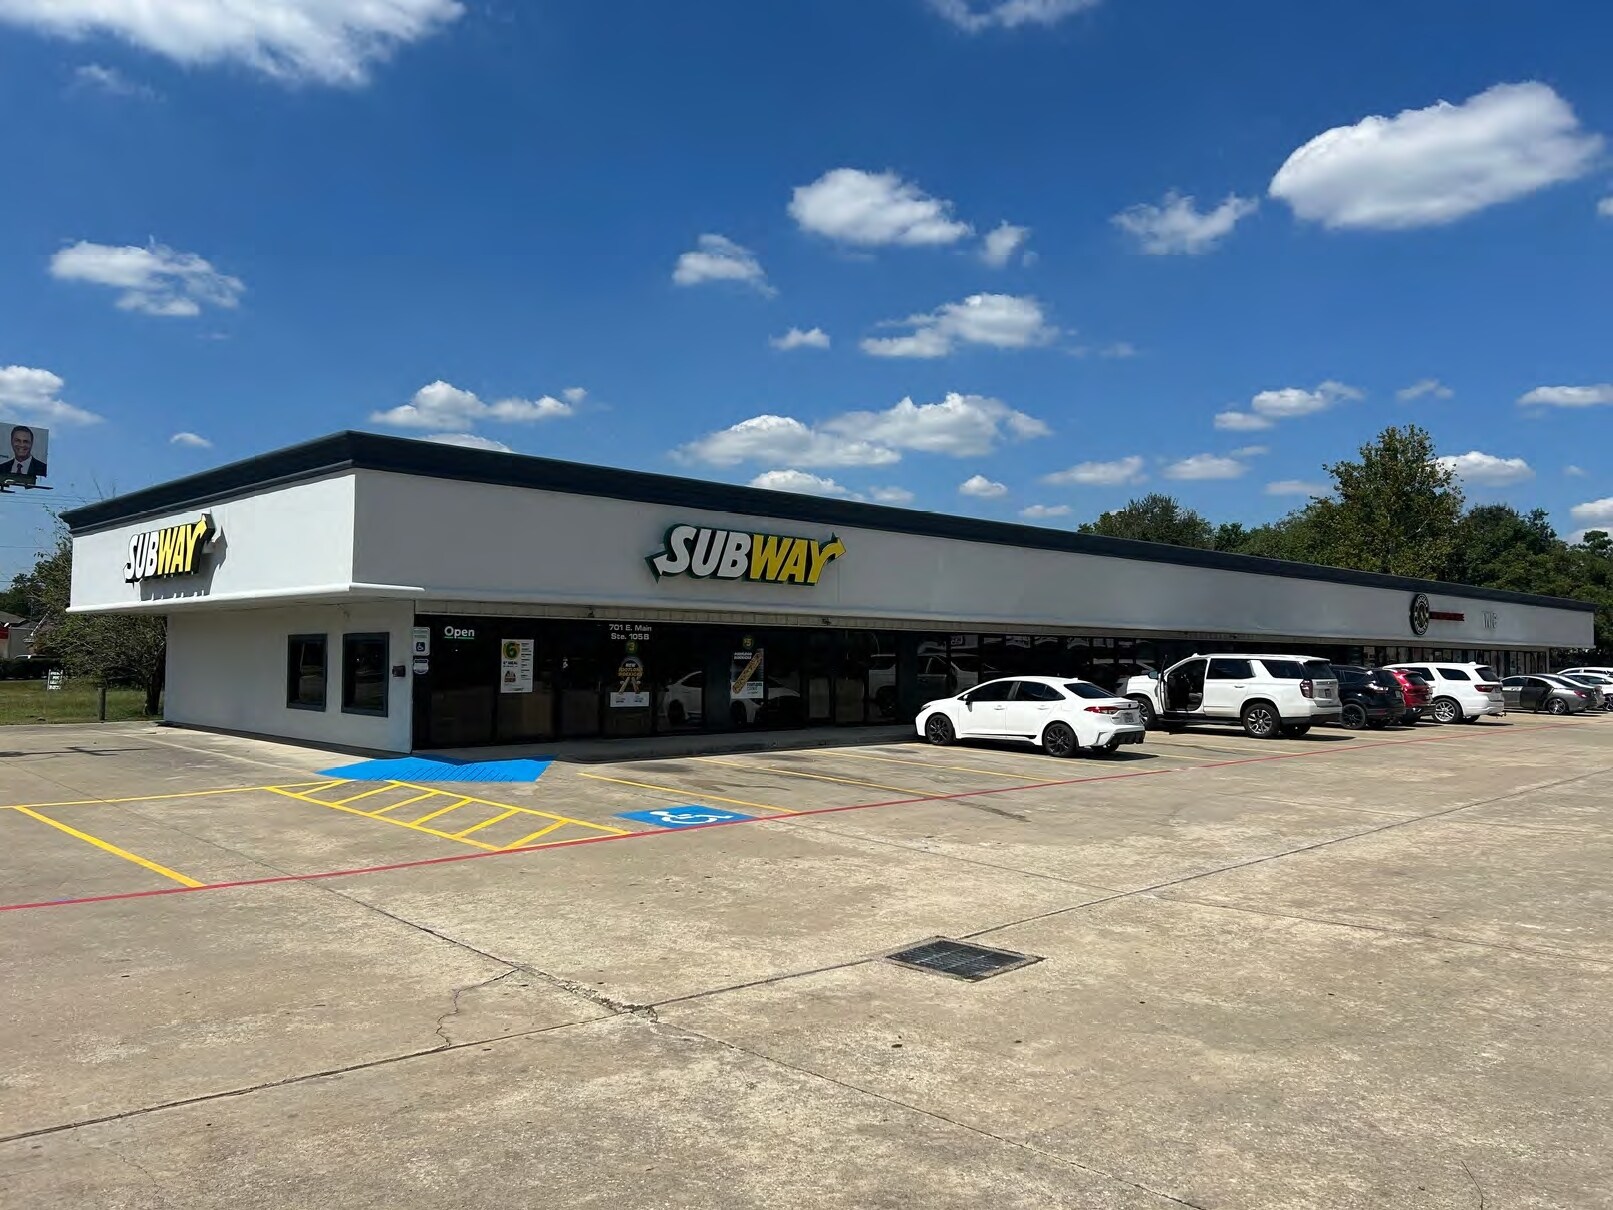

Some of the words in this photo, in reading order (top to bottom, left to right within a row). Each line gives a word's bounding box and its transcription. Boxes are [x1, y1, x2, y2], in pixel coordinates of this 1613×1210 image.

[123, 514, 209, 582] SUBWAY
[648, 524, 846, 585] SUBWAY
[444, 625, 475, 638] Open
[609, 623, 624, 631] 701
[625, 624, 633, 632] E.
[635, 624, 652, 632] Main
[611, 632, 627, 640] Ste.
